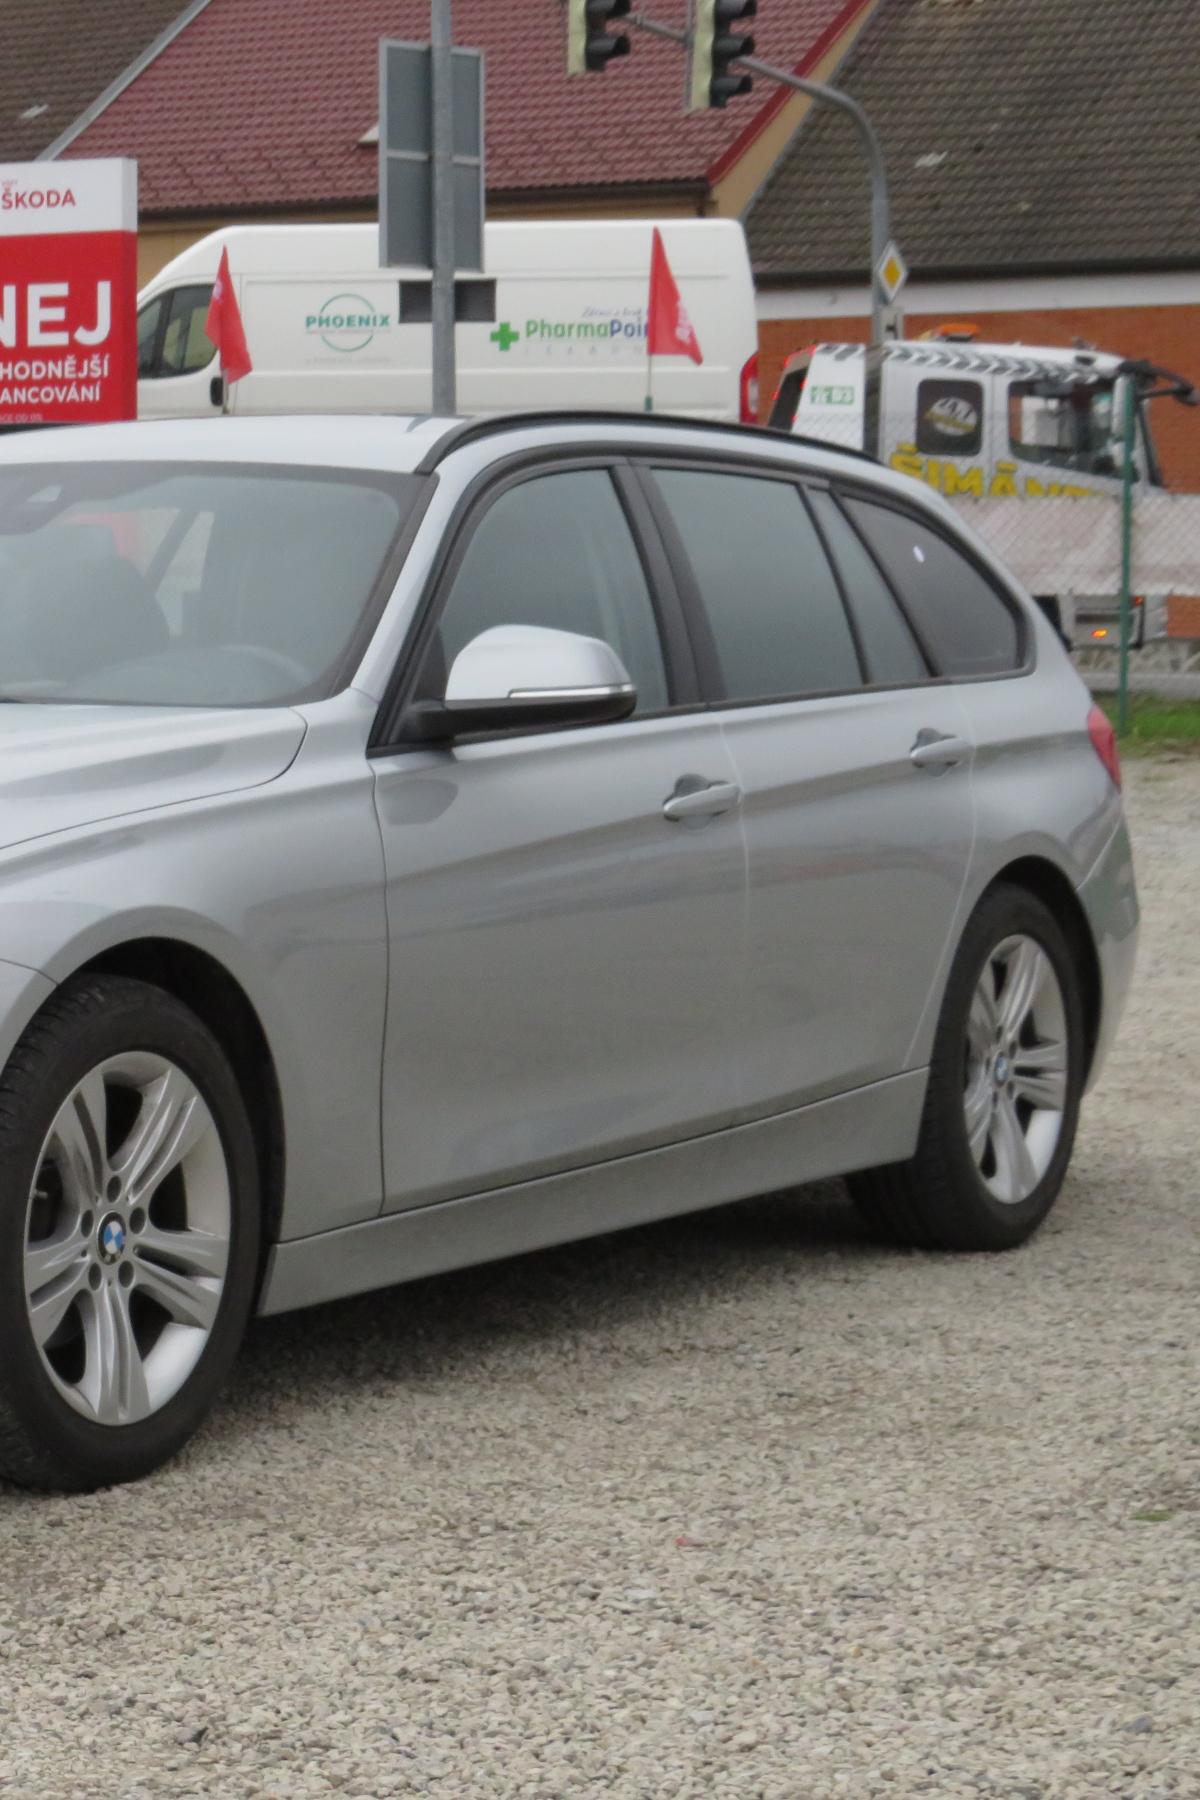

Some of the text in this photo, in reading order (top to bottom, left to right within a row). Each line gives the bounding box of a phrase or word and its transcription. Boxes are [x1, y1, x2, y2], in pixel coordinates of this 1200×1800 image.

[2, 187, 76, 210] ŠKODA
[305, 315, 391, 328] PHOENIX
[525, 319, 648, 339] PharmaPoi
